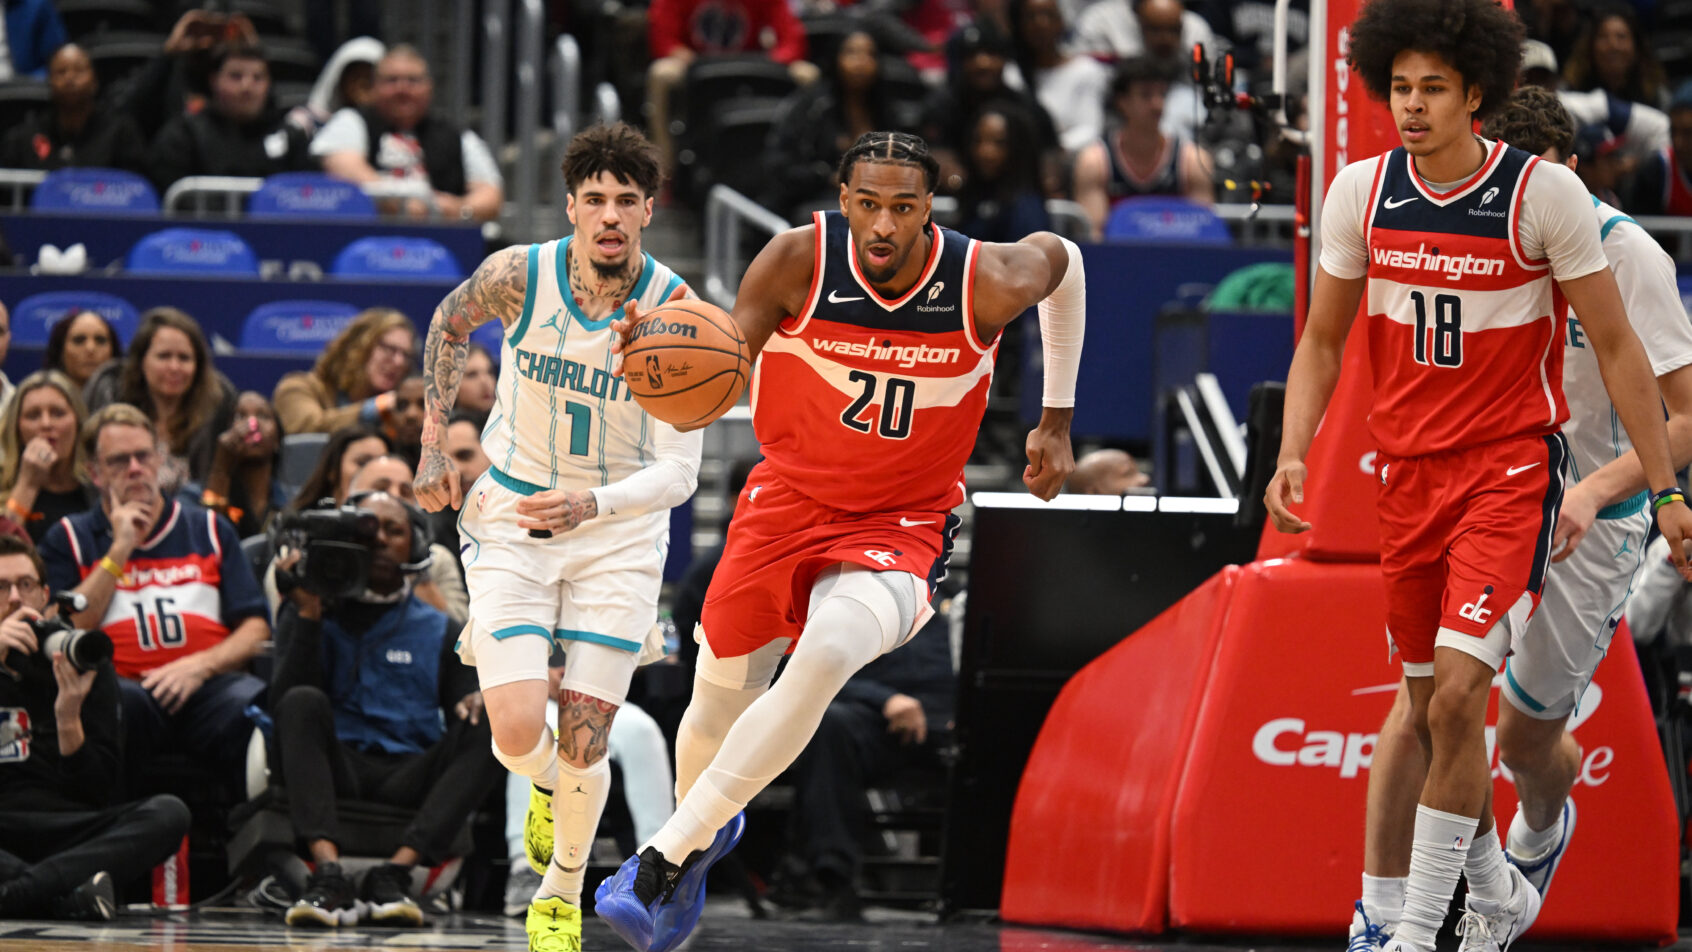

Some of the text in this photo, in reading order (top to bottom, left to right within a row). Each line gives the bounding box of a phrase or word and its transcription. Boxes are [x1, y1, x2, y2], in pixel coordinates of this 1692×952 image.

[1468, 209, 1506, 218] Robinhood
[1373, 243, 1505, 281] washington
[916, 304, 955, 313] Robinhood
[1410, 290, 1464, 369] 18
[813, 337, 960, 368] washington
[840, 369, 916, 441] 20
[565, 400, 592, 457] 1
[131, 597, 188, 652] 16
